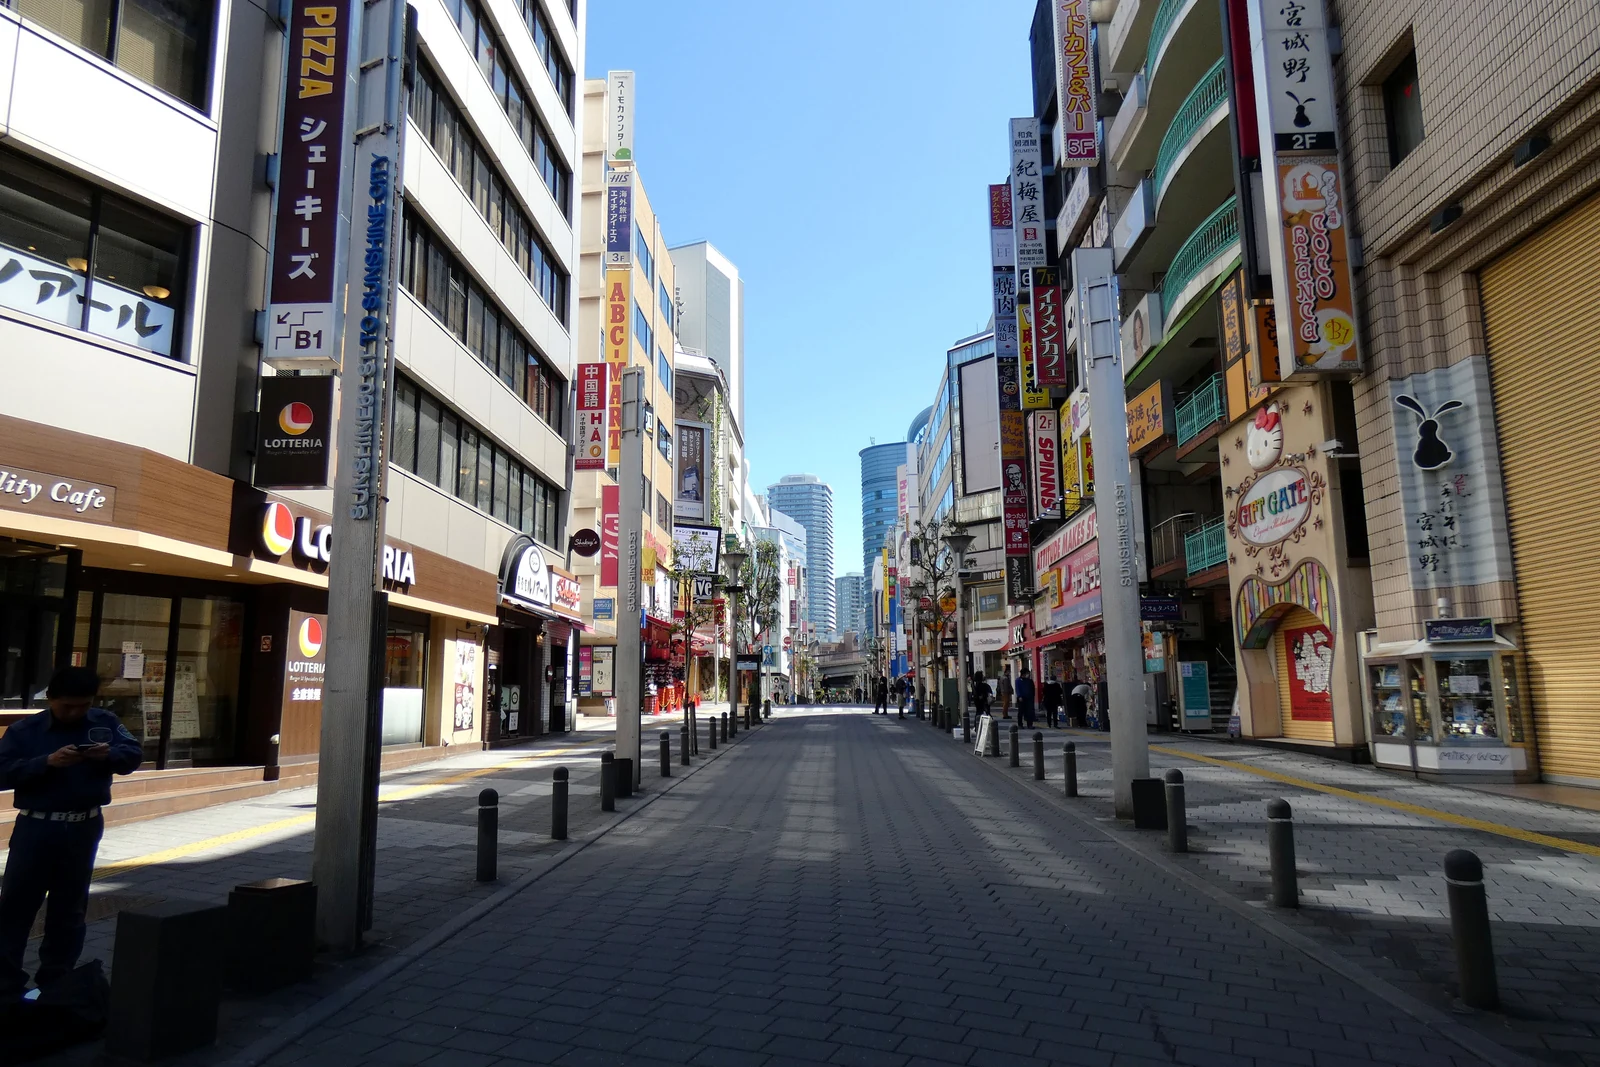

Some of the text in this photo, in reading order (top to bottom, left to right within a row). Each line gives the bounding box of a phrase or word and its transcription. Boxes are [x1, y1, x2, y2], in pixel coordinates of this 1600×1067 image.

[299, 6, 337, 99] PIZZA
[1280, 1, 1311, 83] 宮城野
[617, 80, 625, 147] スーモカウンター
[1014, 139, 1038, 148] 居酒屋
[1018, 131, 1033, 139] 和食
[1068, 139, 1095, 156] 5F
[1292, 134, 1317, 150] 2F
[610, 174, 630, 183] HIS
[1016, 159, 1041, 224] 紀梅屋
[288, 117, 328, 280] シェーキーズ
[619, 190, 628, 223] 海外旅行
[609, 190, 618, 243] エイチ・アイ・エス
[360, 152, 389, 347] TO SUNSHINE CITY
[612, 252, 625, 262] 3F
[1309, 212, 1334, 299] COCO
[1036, 269, 1055, 285] 7F
[995, 277, 1015, 314] 焼肉
[295, 330, 323, 350] B1
[1039, 288, 1059, 377] イケメンカフェ
[1325, 319, 1350, 344] B1
[357, 351, 377, 378] ST
[609, 283, 627, 450] ABC-MART
[584, 365, 599, 408] 中国語
[1027, 396, 1043, 404] 3F
[1039, 415, 1053, 429] 2F
[264, 438, 323, 448] LOTTERIA
[1039, 436, 1057, 513] SPINNS
[1113, 481, 1125, 498] ST
[1454, 474, 1467, 496] 2F
[51, 483, 106, 513] Cafe
[1238, 478, 1307, 528] GIFT GATE
[627, 529, 637, 541] ST
[1006, 519, 1027, 529] 客席
[301, 515, 416, 586] LORIA
[1036, 537, 1061, 572] ATTITUDE
[1062, 519, 1085, 557] MAKES
[1116, 518, 1132, 587] SUNSHINE
[1416, 512, 1440, 572] 宮城野
[627, 558, 637, 612] SUNSHINE
[983, 569, 1005, 580] DOUTO
[1072, 562, 1101, 597] サンドラッ
[288, 660, 326, 674] LOTTERIA
[1439, 750, 1509, 765] Milky Way
